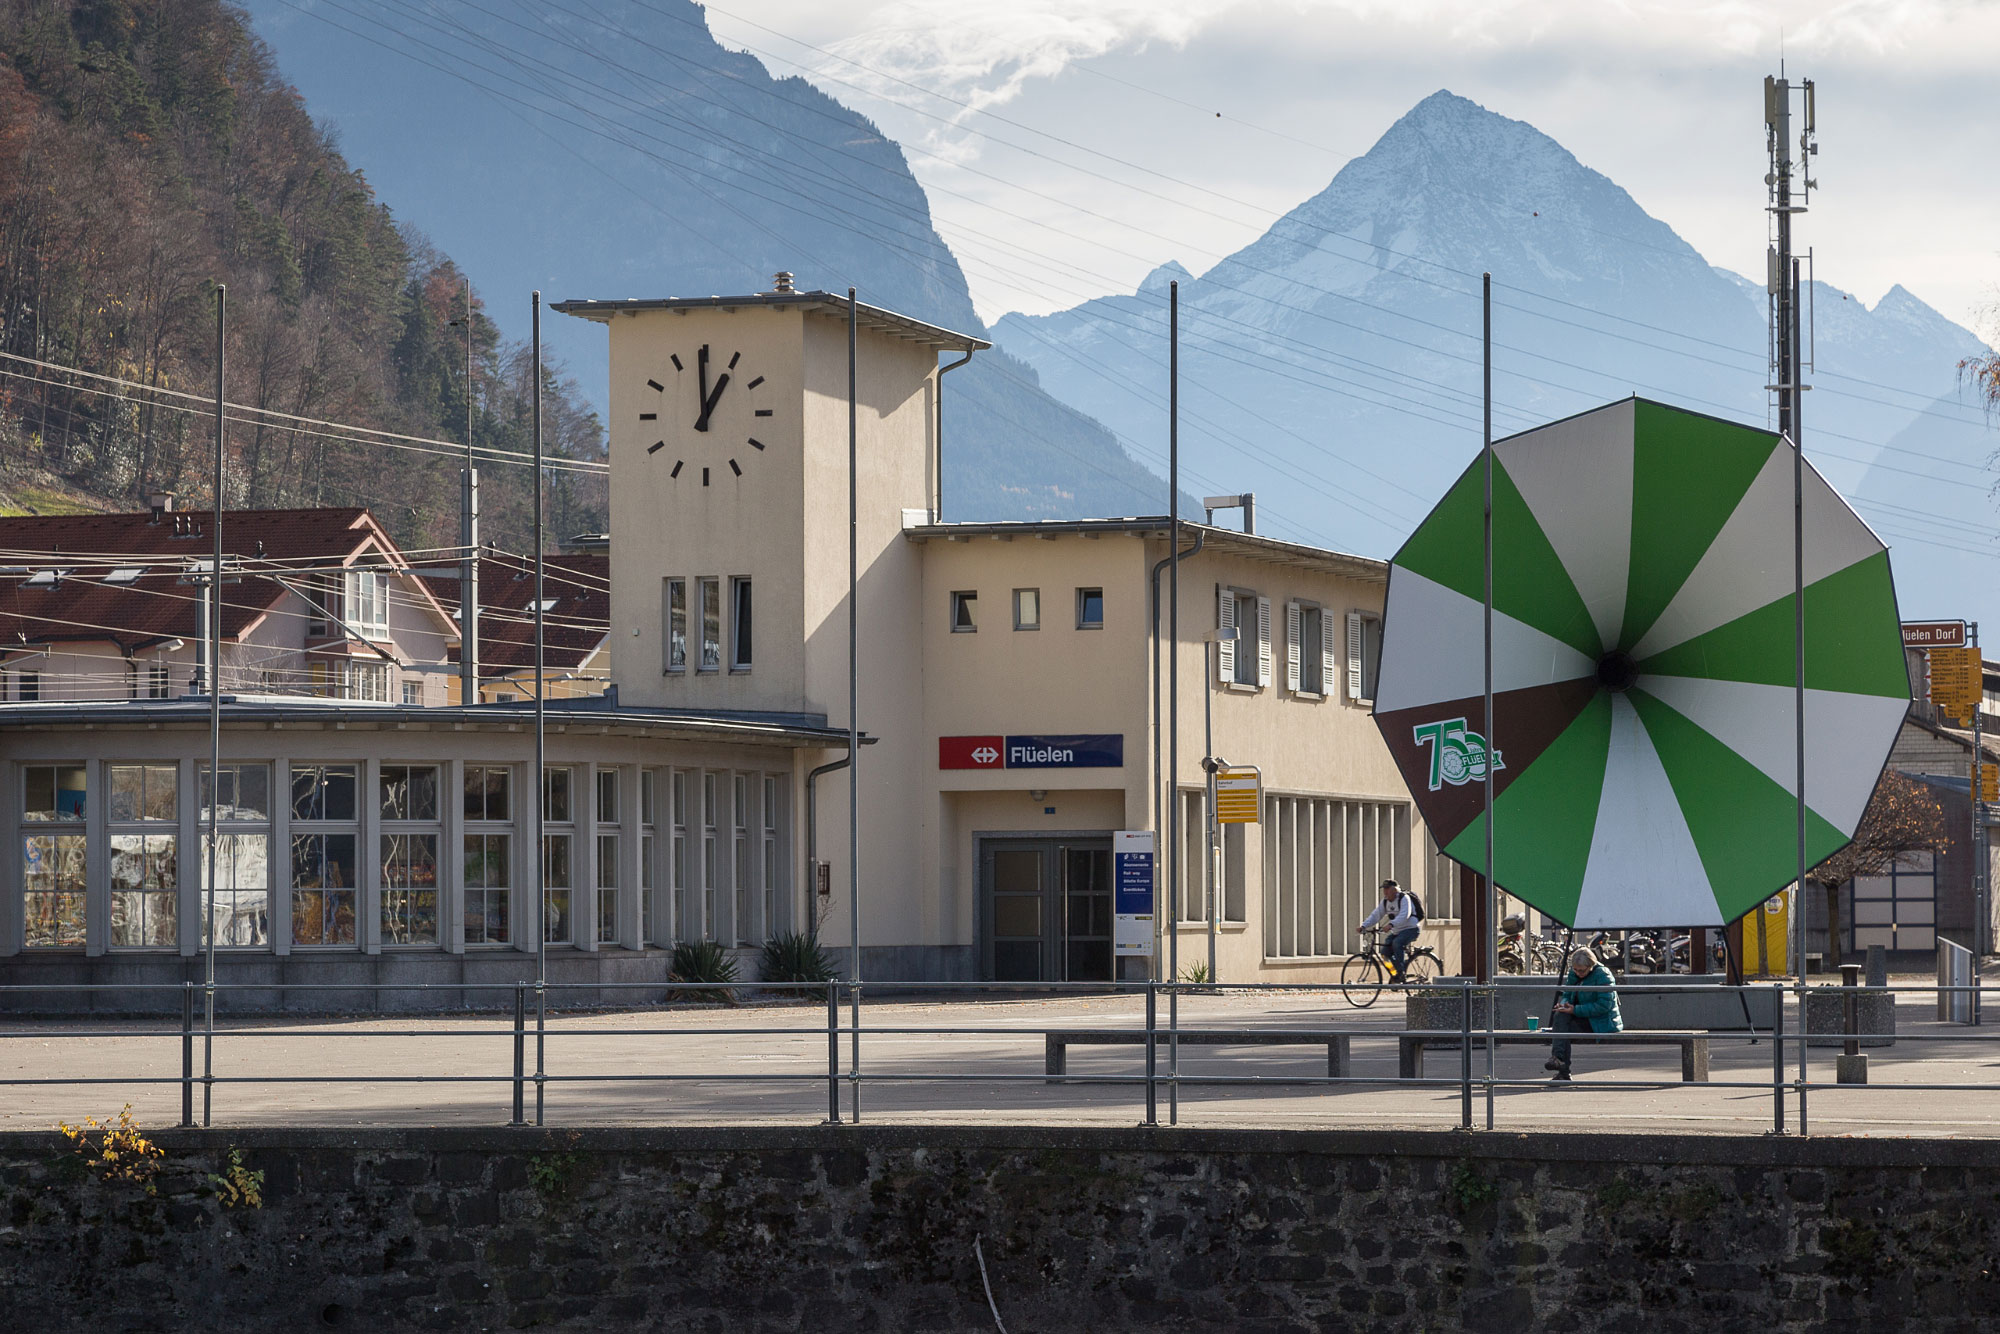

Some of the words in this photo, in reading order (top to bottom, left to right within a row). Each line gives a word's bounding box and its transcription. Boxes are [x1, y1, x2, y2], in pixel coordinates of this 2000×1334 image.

[1902, 628, 1931, 641] lüelen
[1935, 628, 1957, 641] Dorf
[1011, 746, 1074, 763] Flüelen
